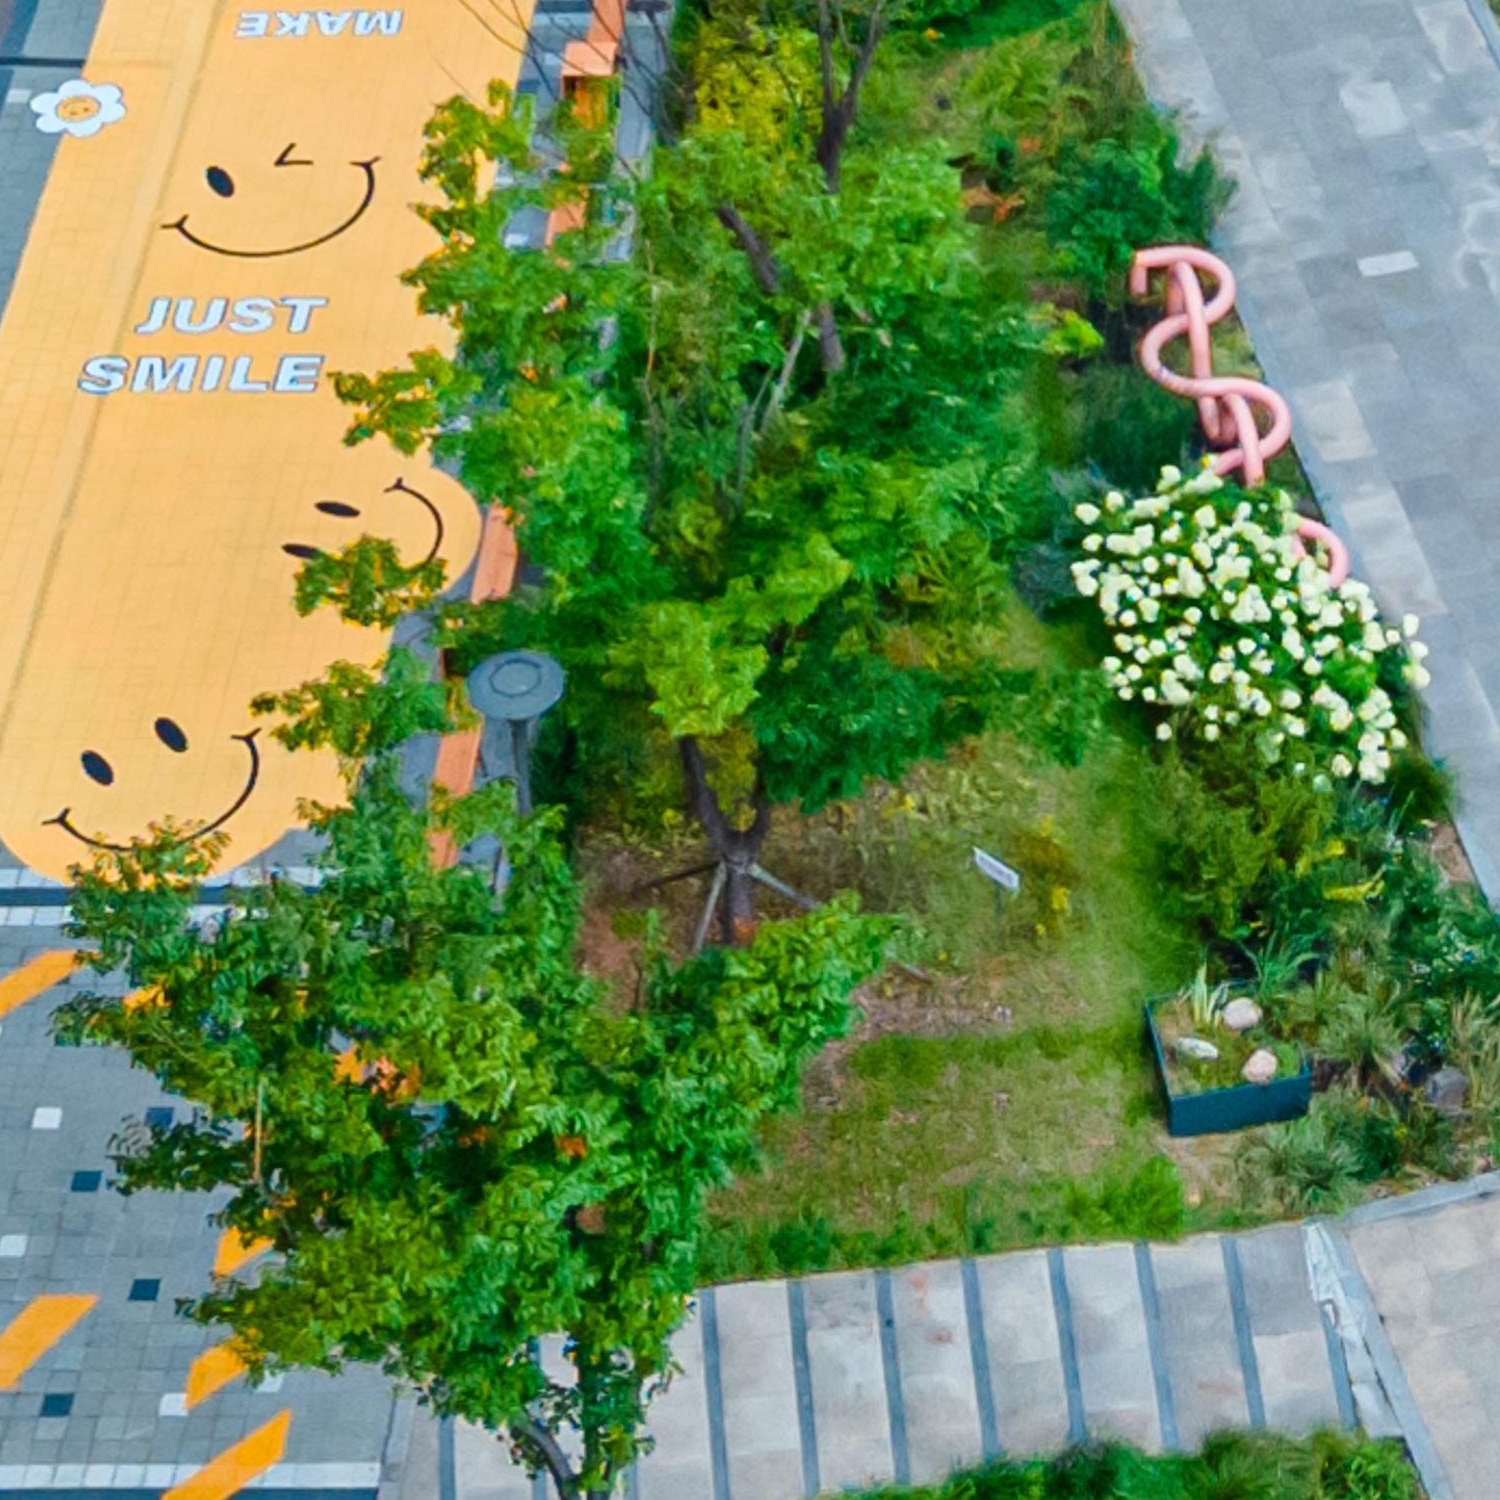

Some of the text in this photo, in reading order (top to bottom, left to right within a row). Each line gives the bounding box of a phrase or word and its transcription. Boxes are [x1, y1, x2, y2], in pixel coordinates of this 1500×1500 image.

[236, 9, 404, 38] MAKE
[135, 296, 328, 335] JUST
[77, 354, 327, 394] SMILE
